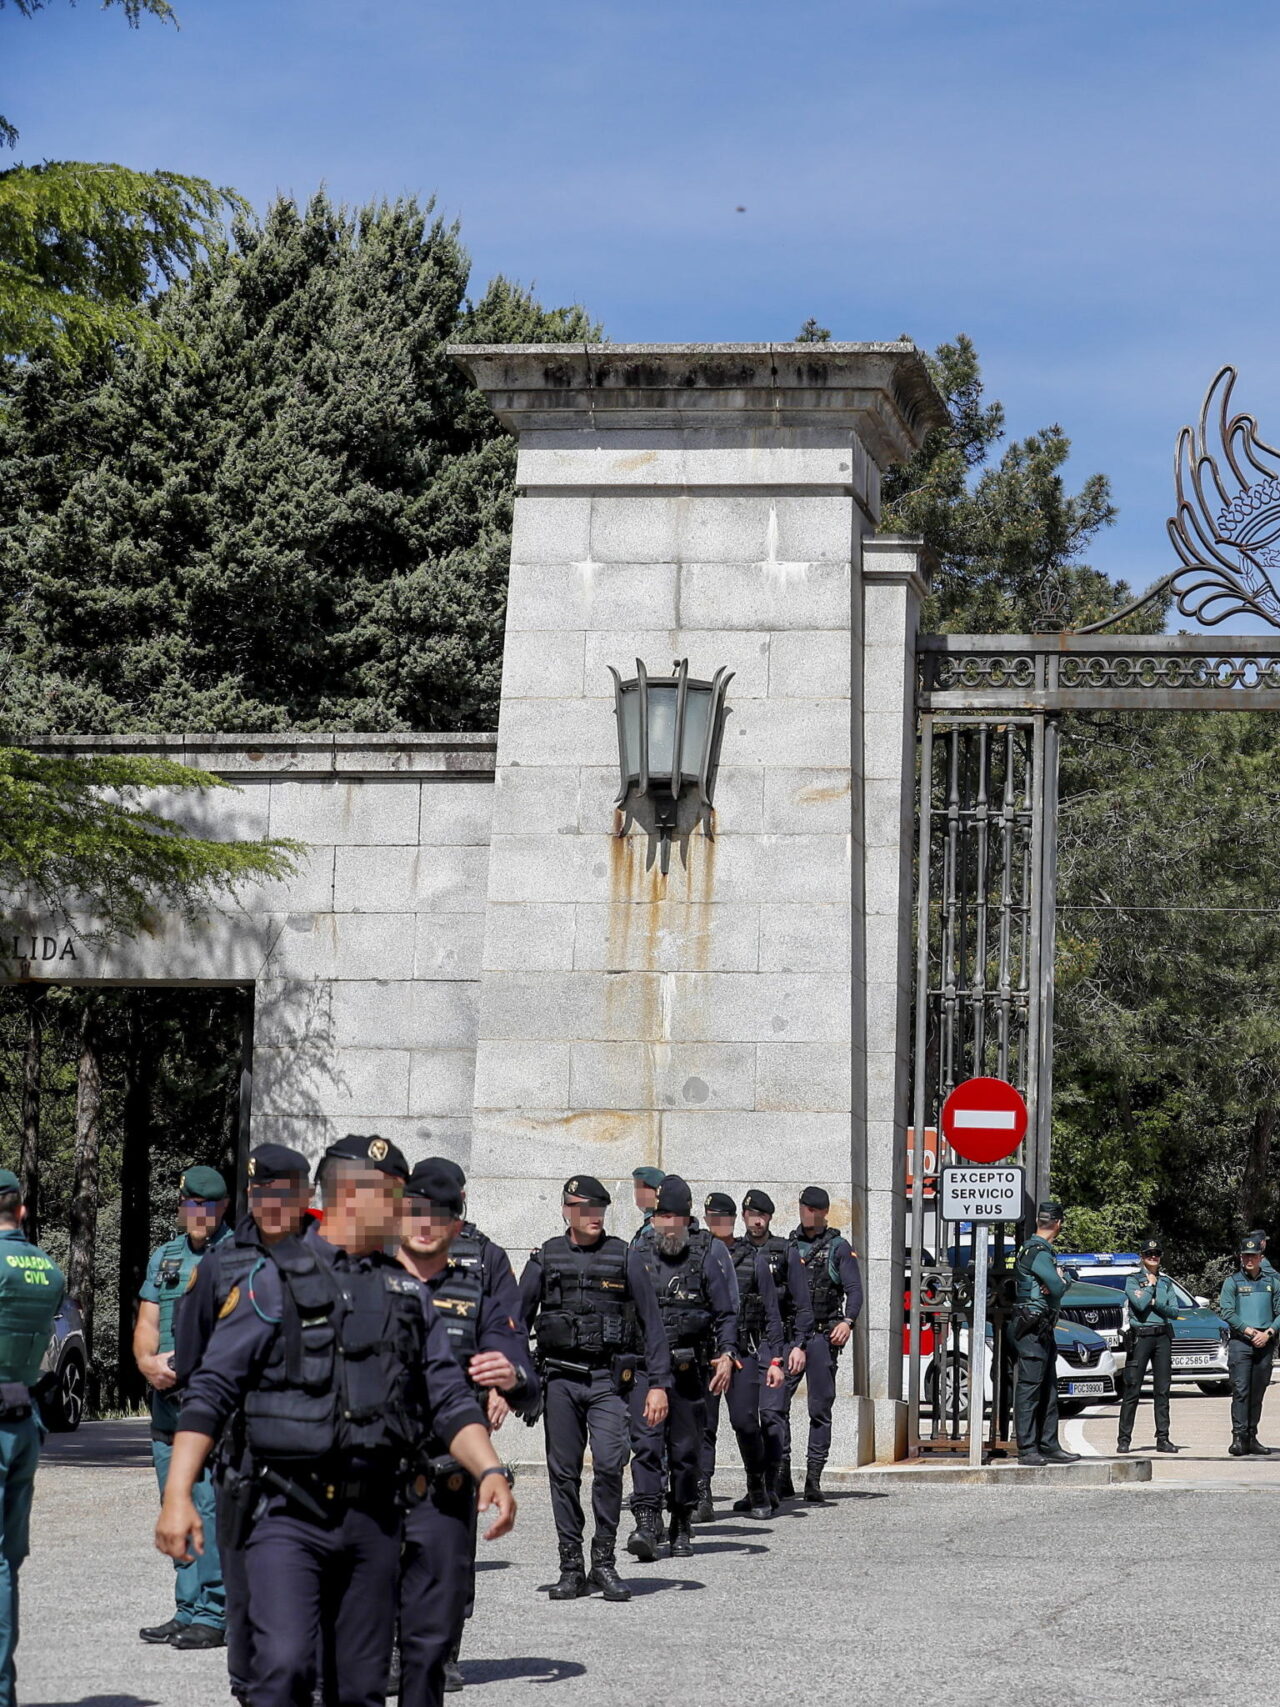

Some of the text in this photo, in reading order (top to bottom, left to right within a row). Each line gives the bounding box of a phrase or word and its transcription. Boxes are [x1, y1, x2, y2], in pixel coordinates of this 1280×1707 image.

[0, 936, 78, 960] LIDA
[950, 1172, 1015, 1183] EXCEPTO
[951, 1188, 1014, 1199] SERVICIO
[963, 1204, 1003, 1215] Y BUS
[6, 1255, 54, 1270] GUARDIA
[24, 1269, 50, 1286] CIVIL
